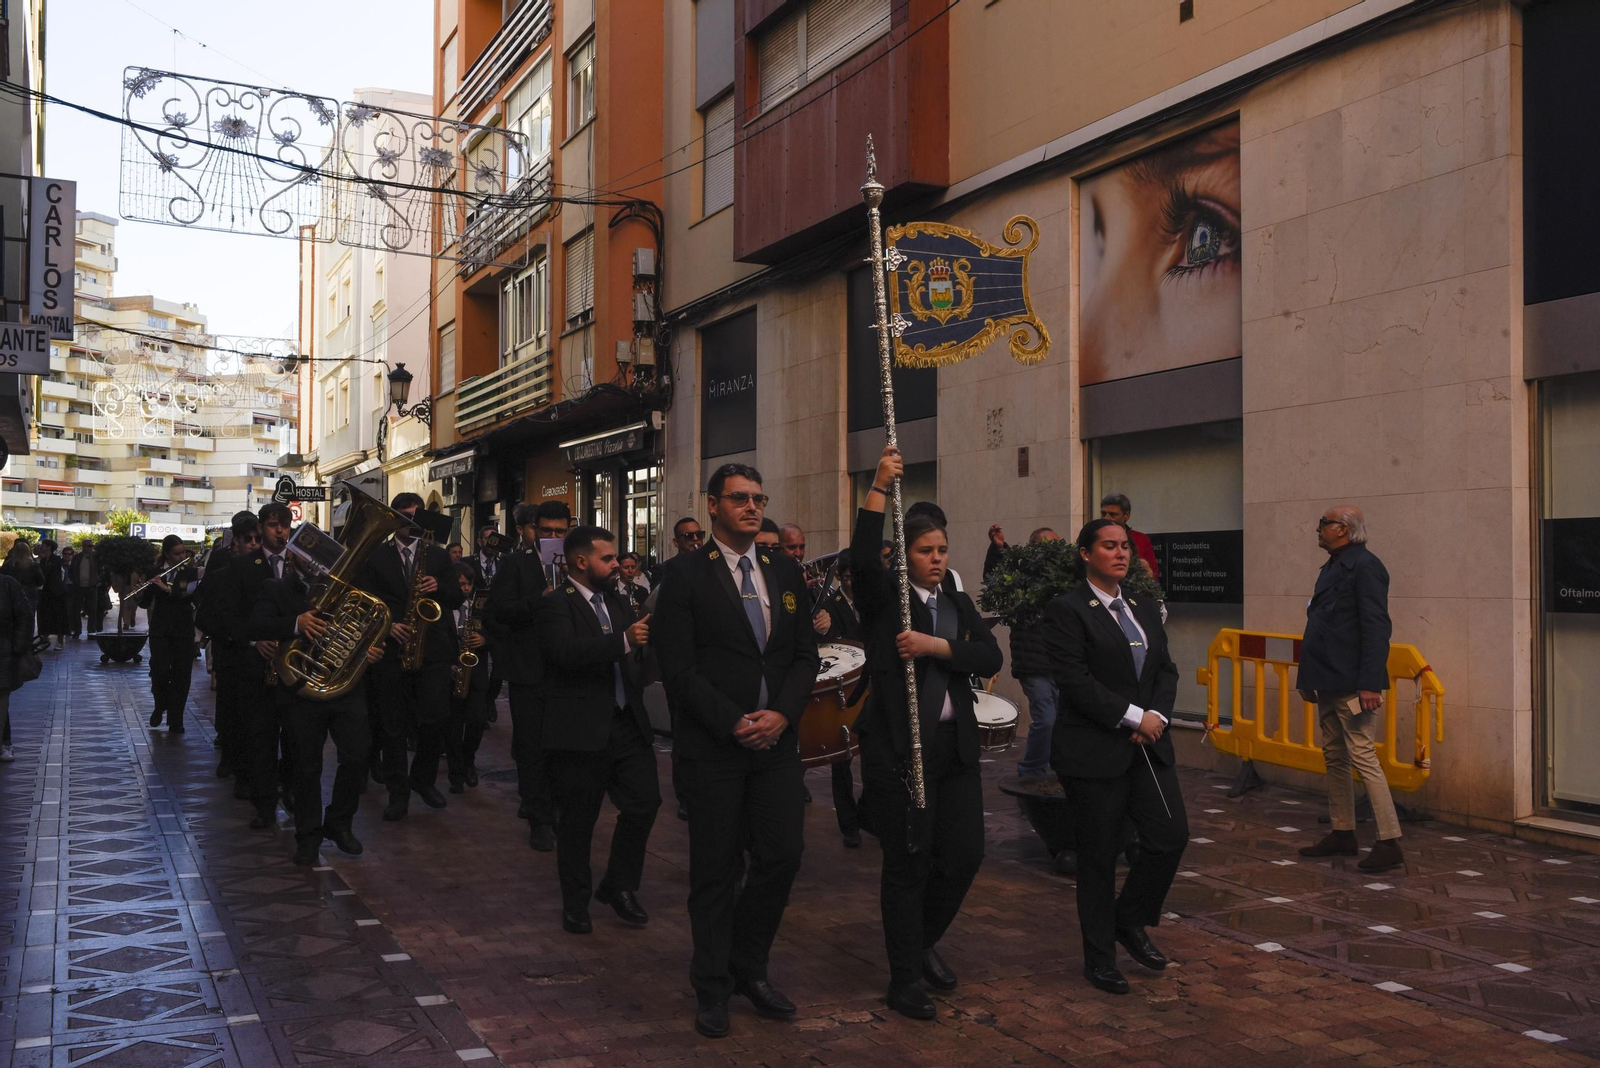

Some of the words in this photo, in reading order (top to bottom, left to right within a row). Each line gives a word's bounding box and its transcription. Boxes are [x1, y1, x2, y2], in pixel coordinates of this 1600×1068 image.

[43, 183, 63, 310] CARLOS
[30, 314, 71, 333] HOSTAL
[0, 328, 46, 352] ANTE
[708, 373, 755, 400] MIRANZA
[295, 488, 325, 498] HOSTAL
[133, 525, 143, 537] P
[1172, 541, 1210, 551] Oculoplastics
[1172, 556, 1203, 565] Presbyopia
[1172, 570, 1190, 578] Retina
[1191, 570, 1202, 578] and
[1203, 569, 1227, 578] vitreous
[1202, 584, 1225, 593] surgery
[1559, 588, 1600, 598] Oftalmo
